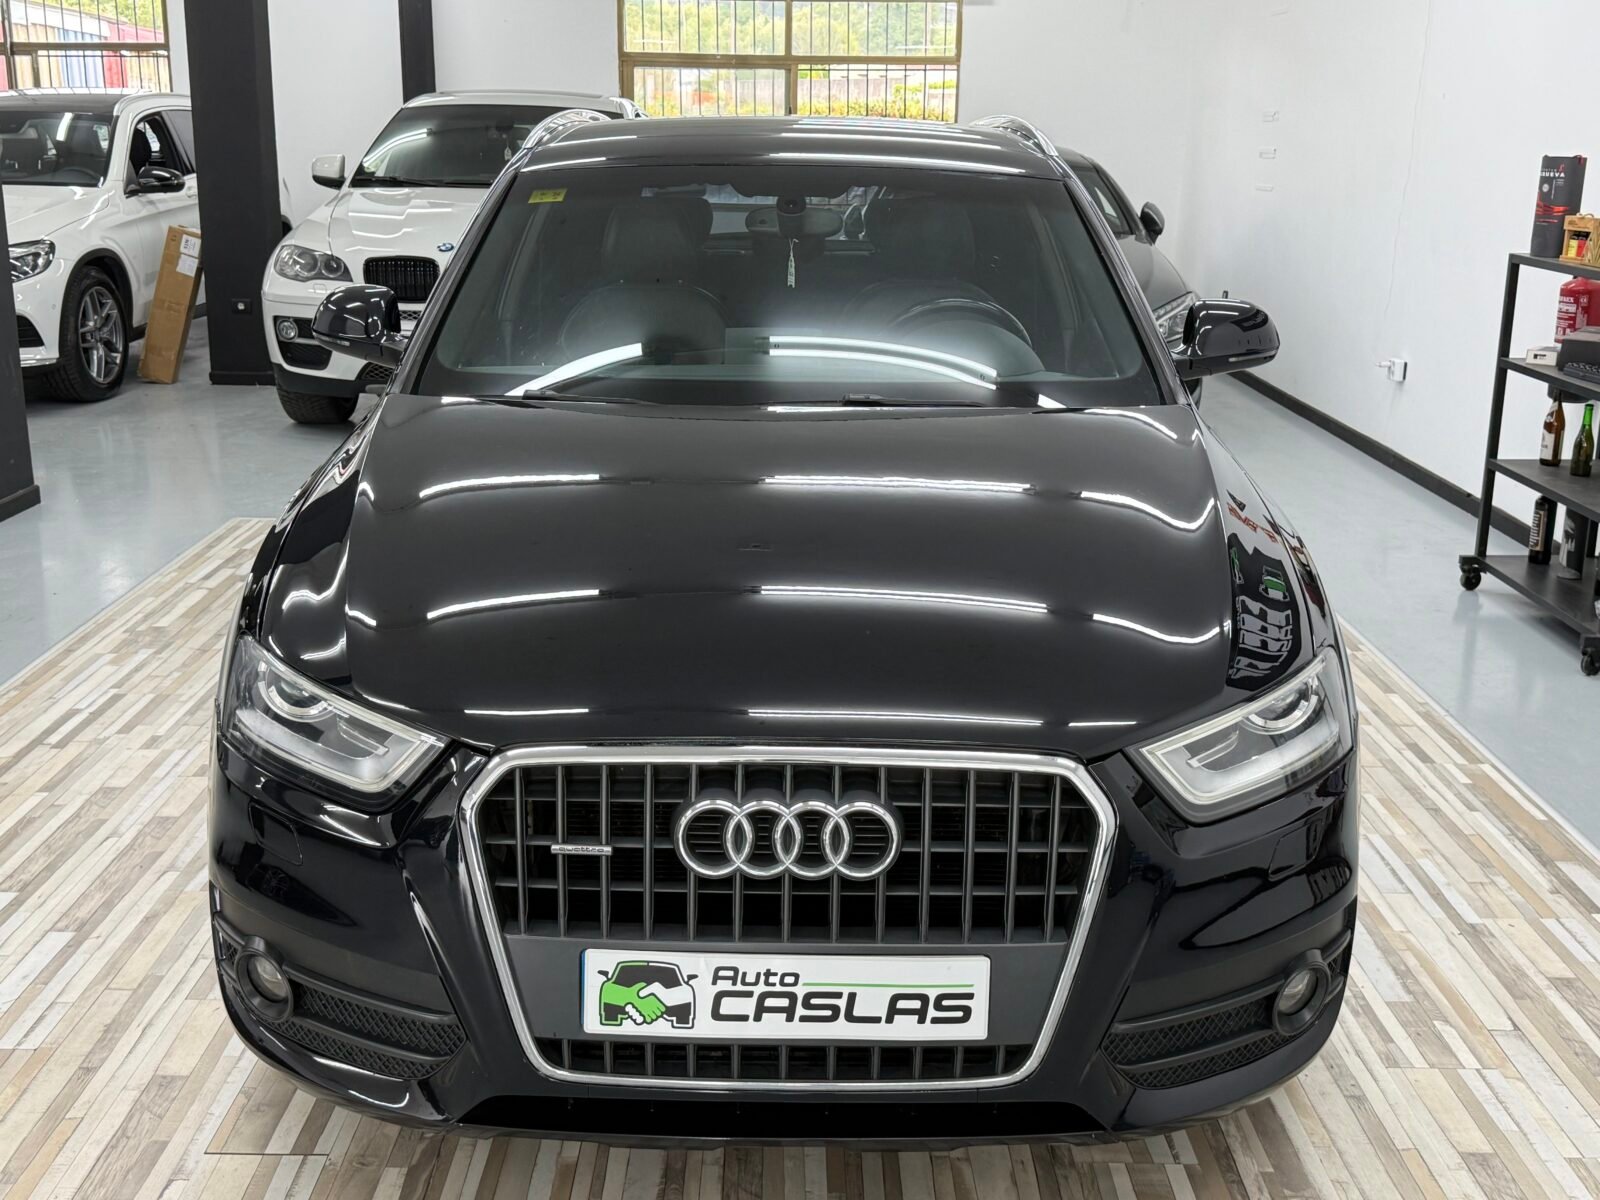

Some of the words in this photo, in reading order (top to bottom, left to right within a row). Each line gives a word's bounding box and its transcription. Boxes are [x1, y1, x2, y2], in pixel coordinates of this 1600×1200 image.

[558, 846, 605, 854] quattro
[711, 965, 800, 988] Auto
[710, 989, 975, 1025] CASLAS
